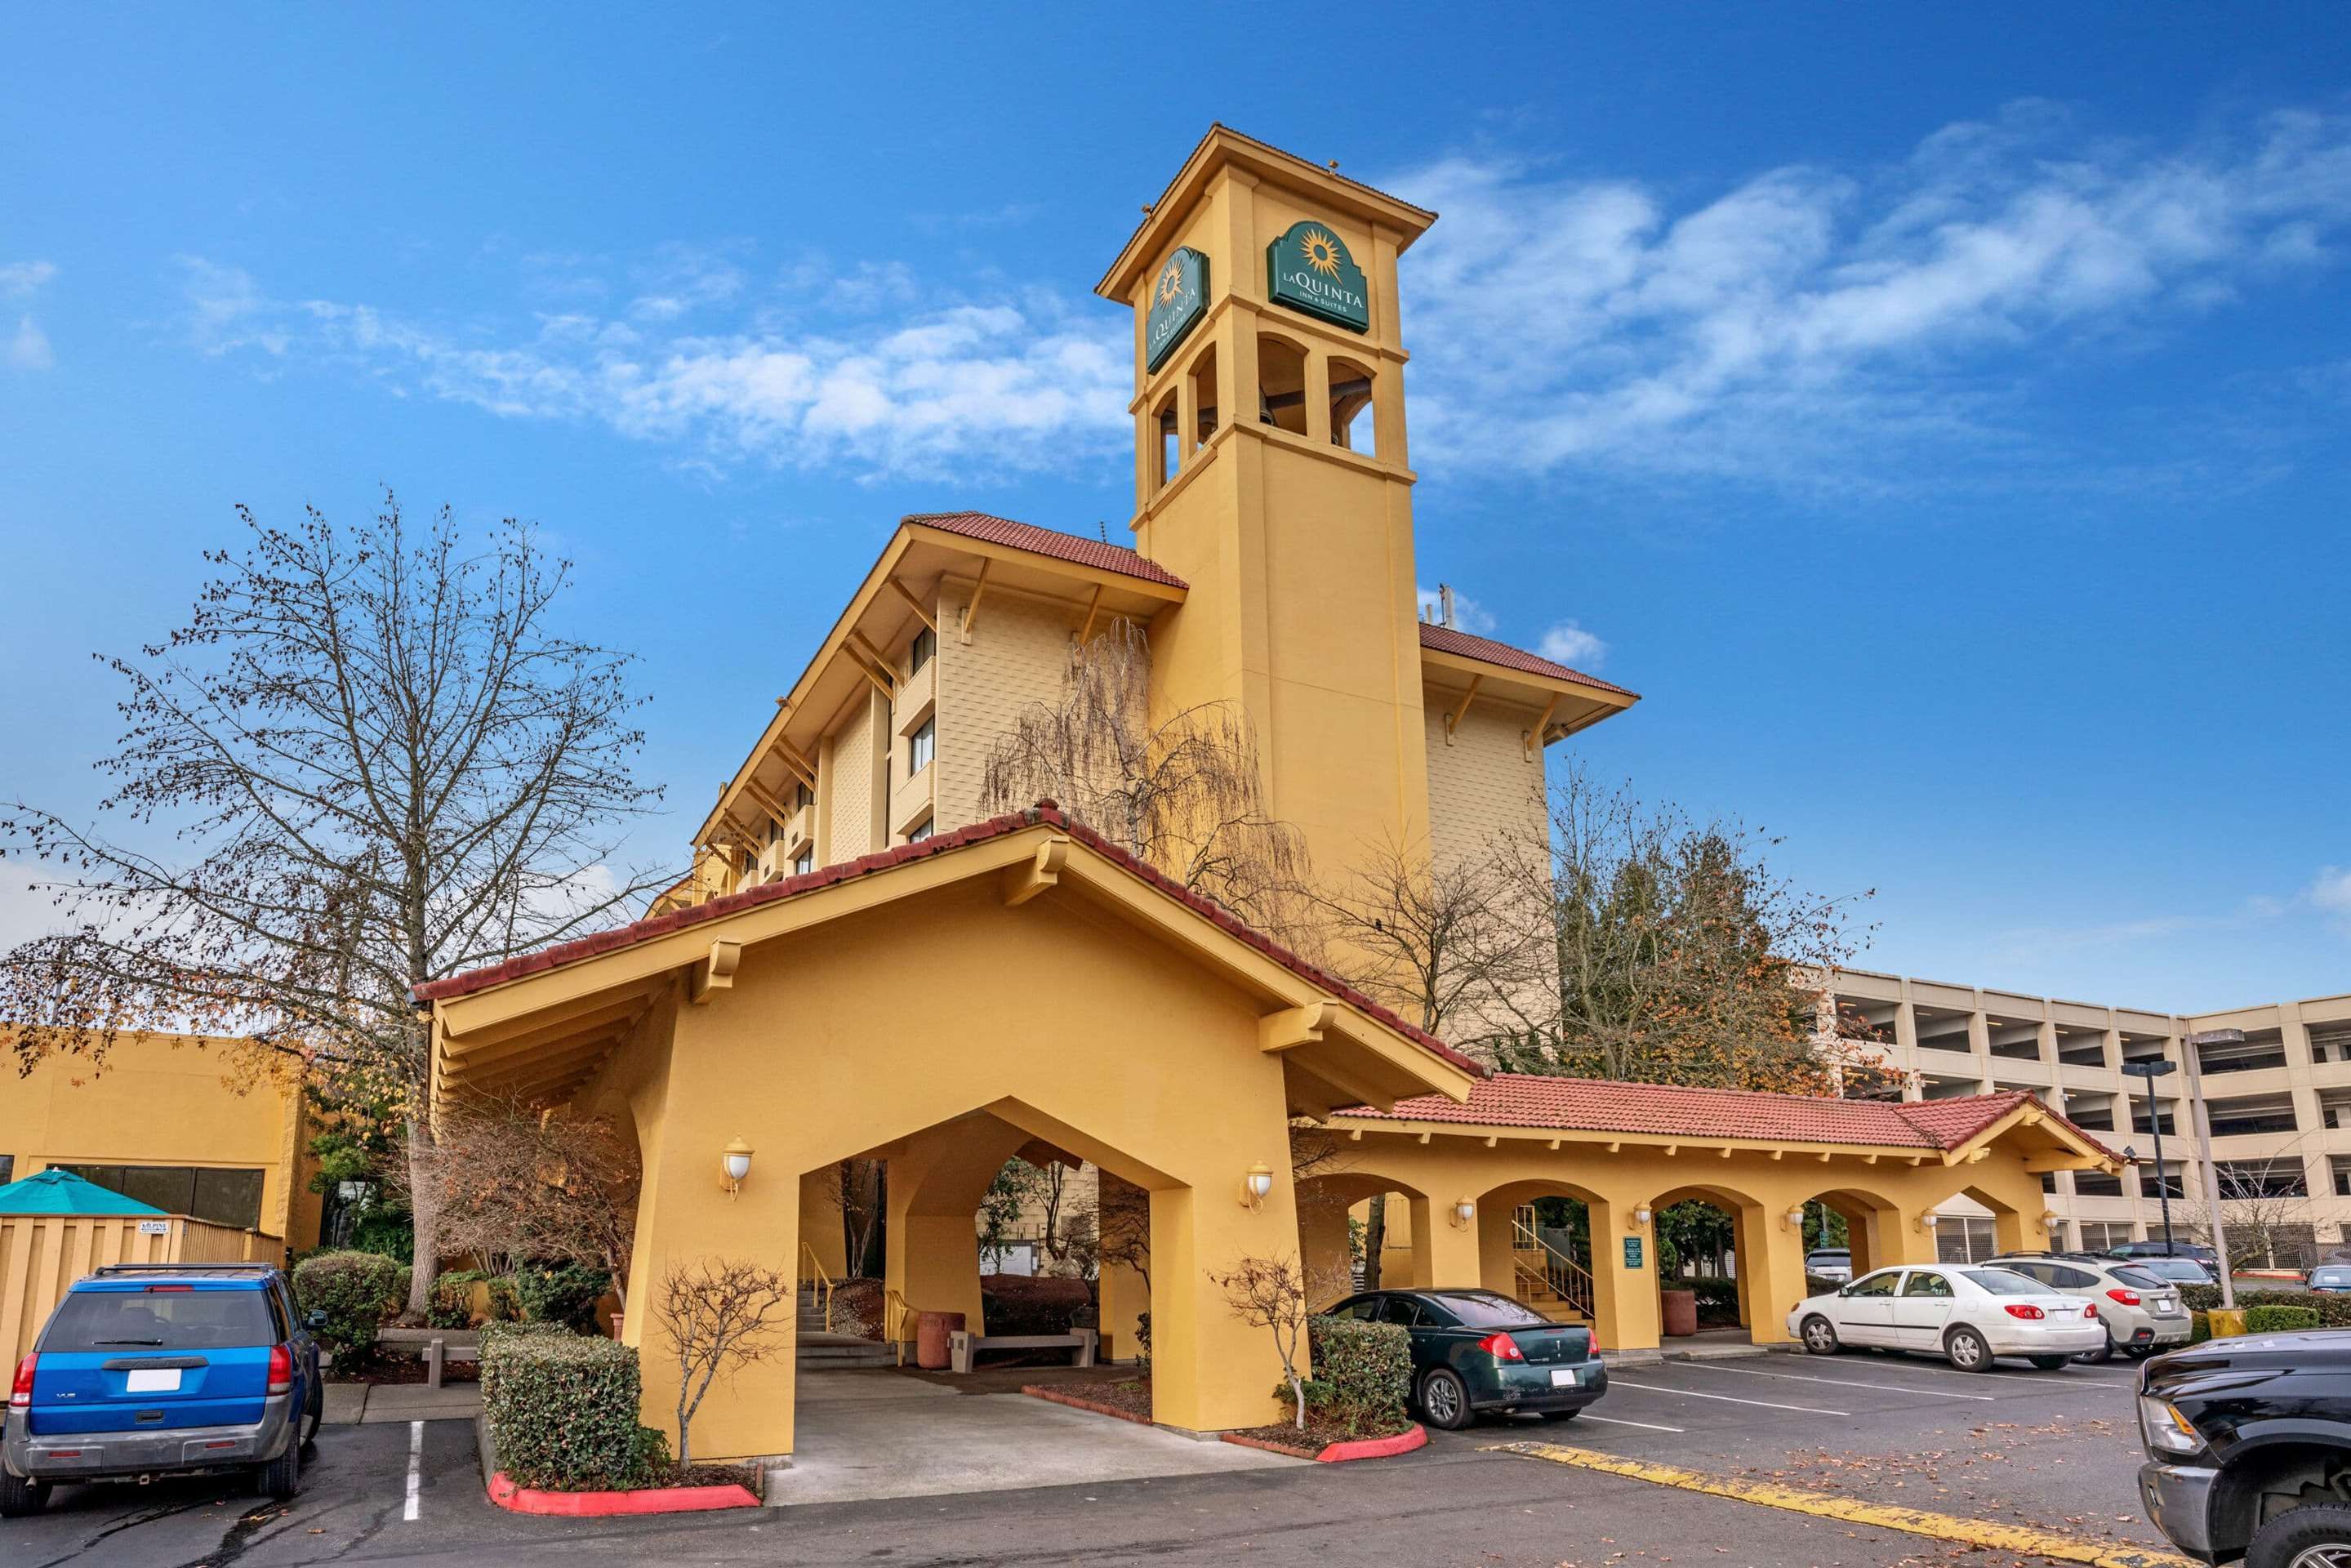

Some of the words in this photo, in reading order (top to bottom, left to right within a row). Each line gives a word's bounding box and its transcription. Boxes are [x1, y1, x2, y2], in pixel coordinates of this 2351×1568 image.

[1284, 273, 1295, 283] LA
[1296, 272, 1365, 308] QUINTA
[1321, 298, 1347, 312] SUITES
[1156, 287, 1196, 340] QUINTA
